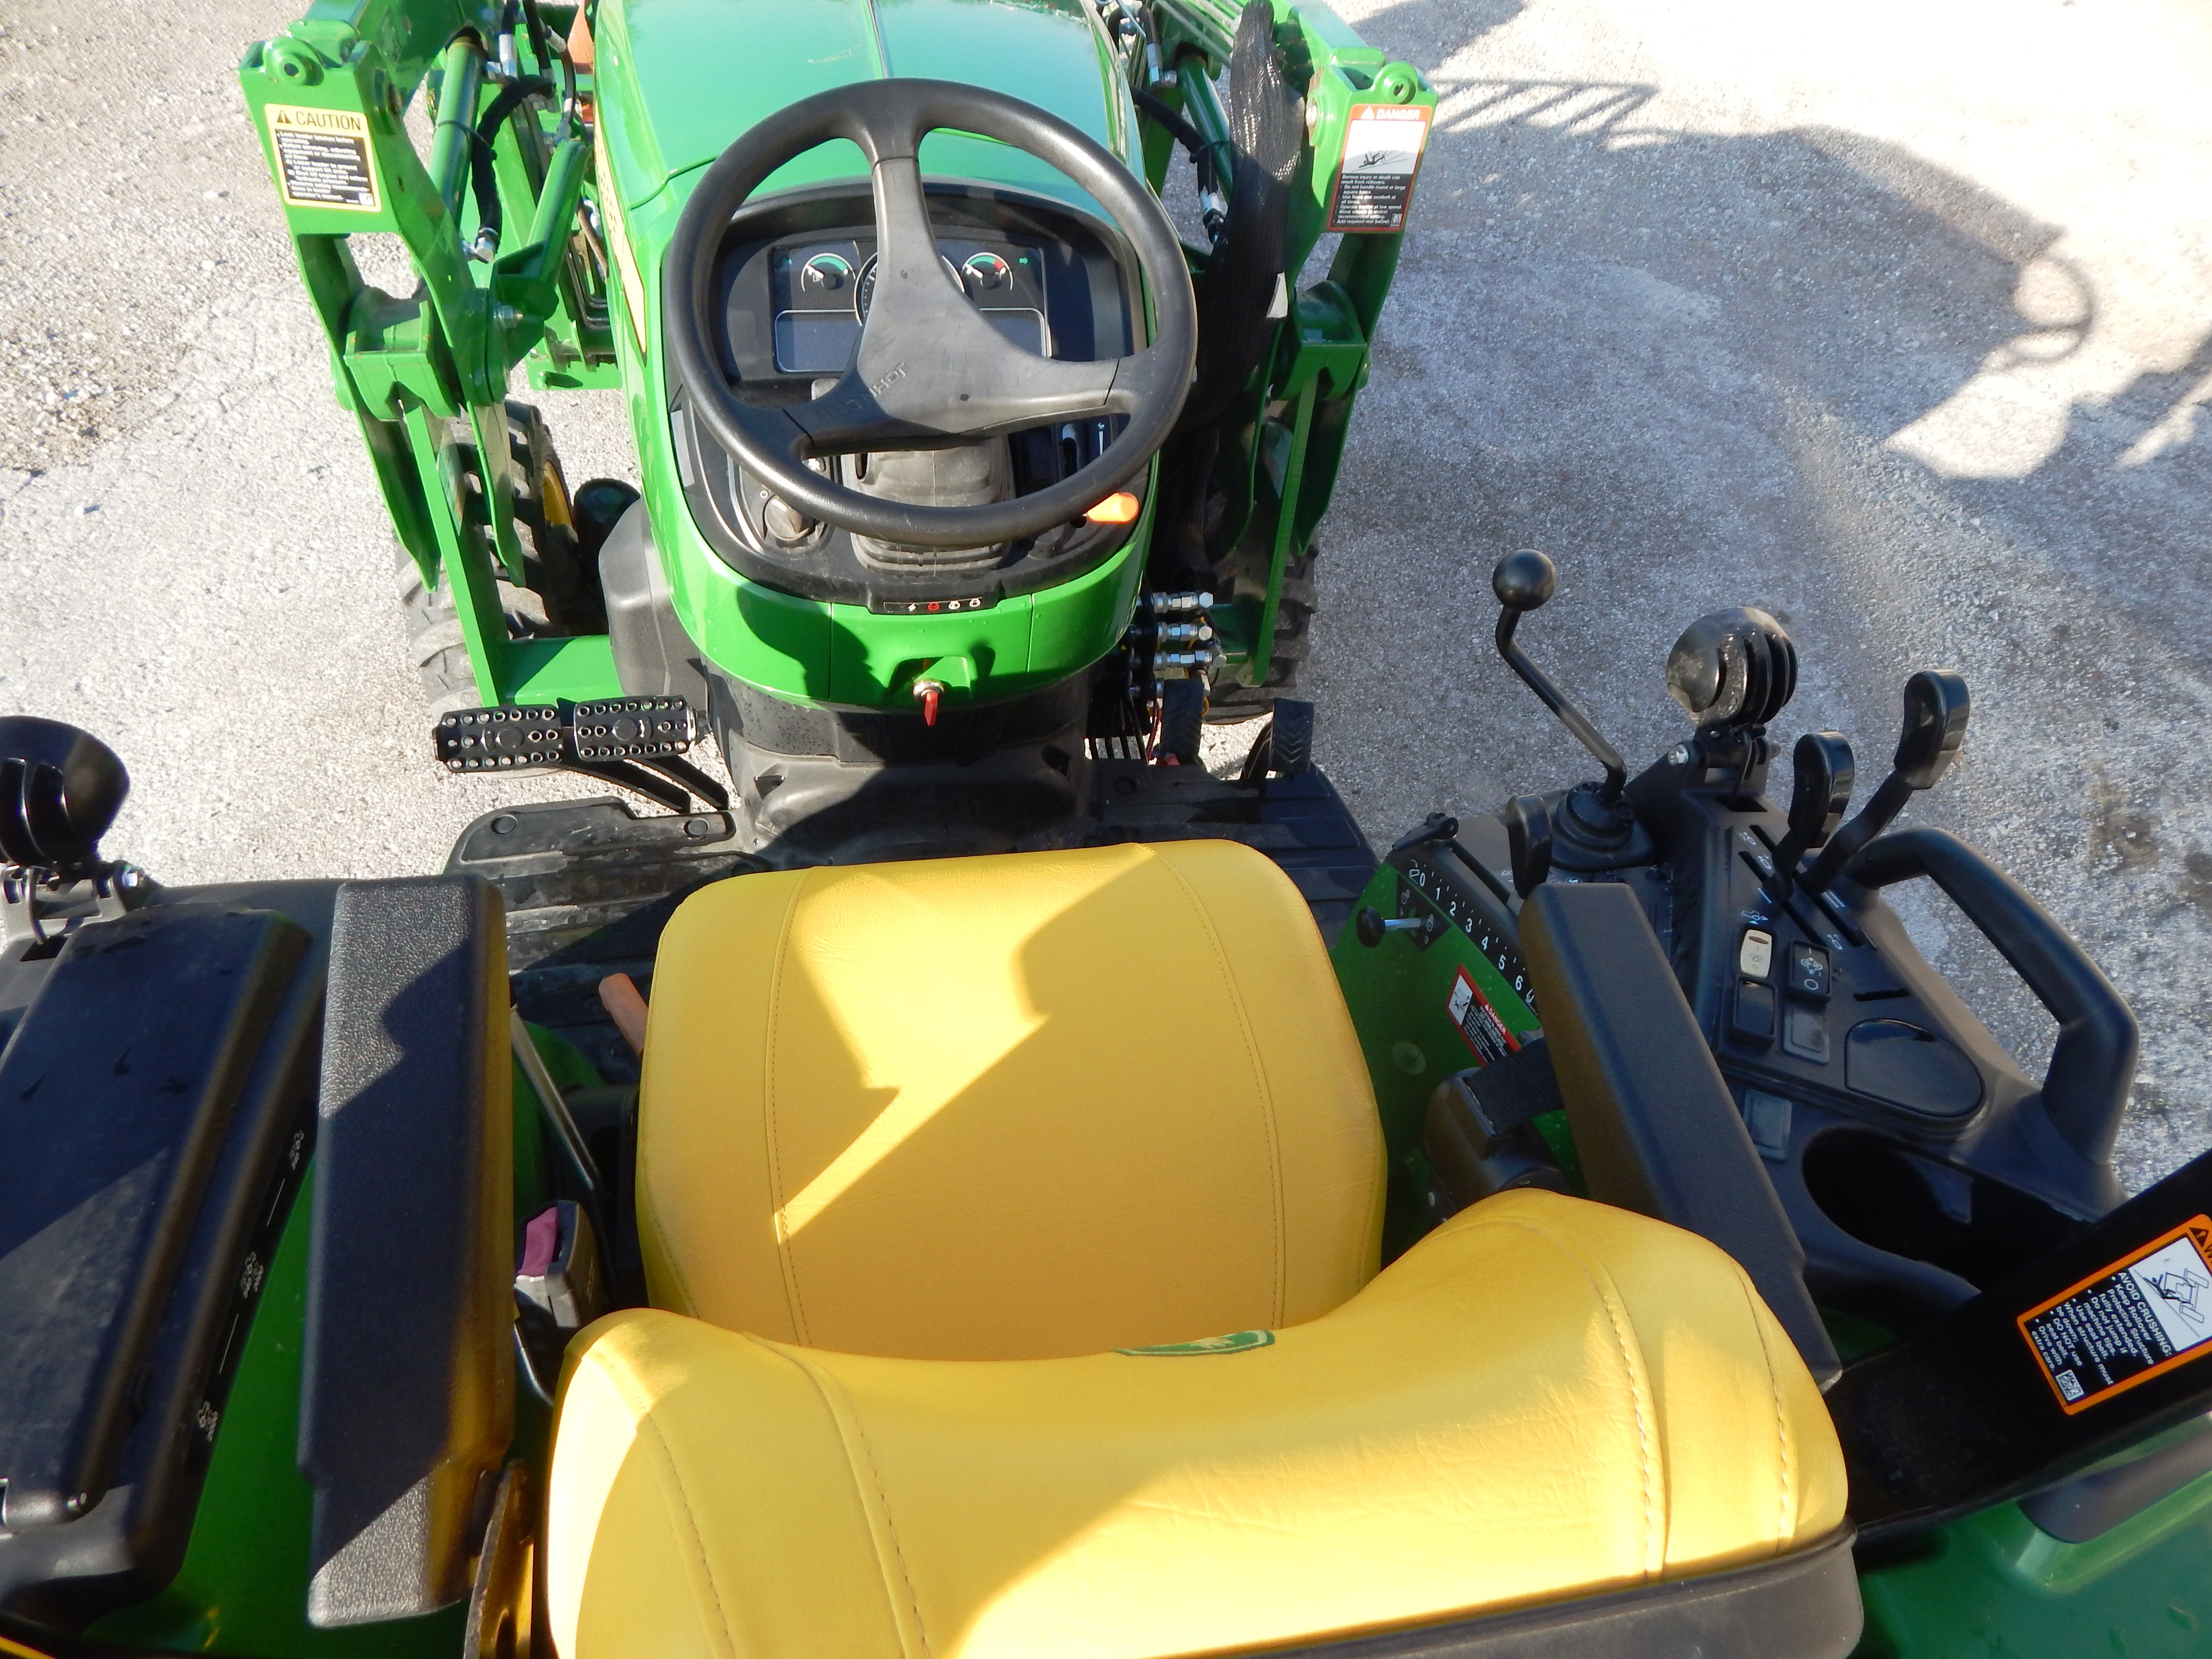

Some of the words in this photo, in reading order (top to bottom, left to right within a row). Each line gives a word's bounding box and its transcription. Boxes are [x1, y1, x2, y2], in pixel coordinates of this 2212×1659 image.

[296, 111, 361, 131] CAUTION
[1419, 872, 1426, 887] 0
[1436, 887, 1442, 901] 1
[1450, 901, 1456, 916] 2
[1466, 918, 1472, 933] 3
[1481, 935, 1489, 950] 4
[1498, 954, 1506, 970] 5
[1515, 975, 1523, 991] 6
[1489, 1008, 1506, 1034] DANGER
[2056, 1306, 2065, 1317] be
[2063, 1318, 2079, 1343] down;
[2076, 1305, 2087, 1322] Use
[2085, 1322, 2099, 1340] seat
[2095, 1340, 2108, 1359] belt.
[2083, 1302, 2106, 1336] machine
[2104, 1337, 2116, 1356] tips.
[2091, 1297, 2100, 1309] Do
[2098, 1310, 2110, 1324] not
[2105, 1324, 2122, 1346] jump
[2099, 1293, 2114, 1312] fully
[2111, 1314, 2138, 1356] extended.
[2107, 1289, 2132, 1327] Protective
[2130, 1328, 2153, 1364] Structure
[2115, 1284, 2130, 1305] Keep
[2128, 1306, 2152, 1340] Rollover
[2118, 1273, 2140, 1300] AVOID
[2137, 1302, 2172, 1356] CRUSHING:
[2032, 1331, 2045, 1350] extra
[2043, 1351, 2055, 1371] care.
[2038, 1325, 2052, 1347] Drive
[2050, 1347, 2062, 1365] with
[2046, 1323, 2059, 1340] seat
[2056, 1340, 2068, 1358] belt.
[2053, 1318, 2064, 1331] DO
[2060, 1332, 2075, 1348] NOT
[2071, 1351, 2082, 1366] use
[2064, 1301, 2079, 1325] When
[2077, 1326, 2100, 1362] structure
[2098, 1364, 2114, 1385] must
